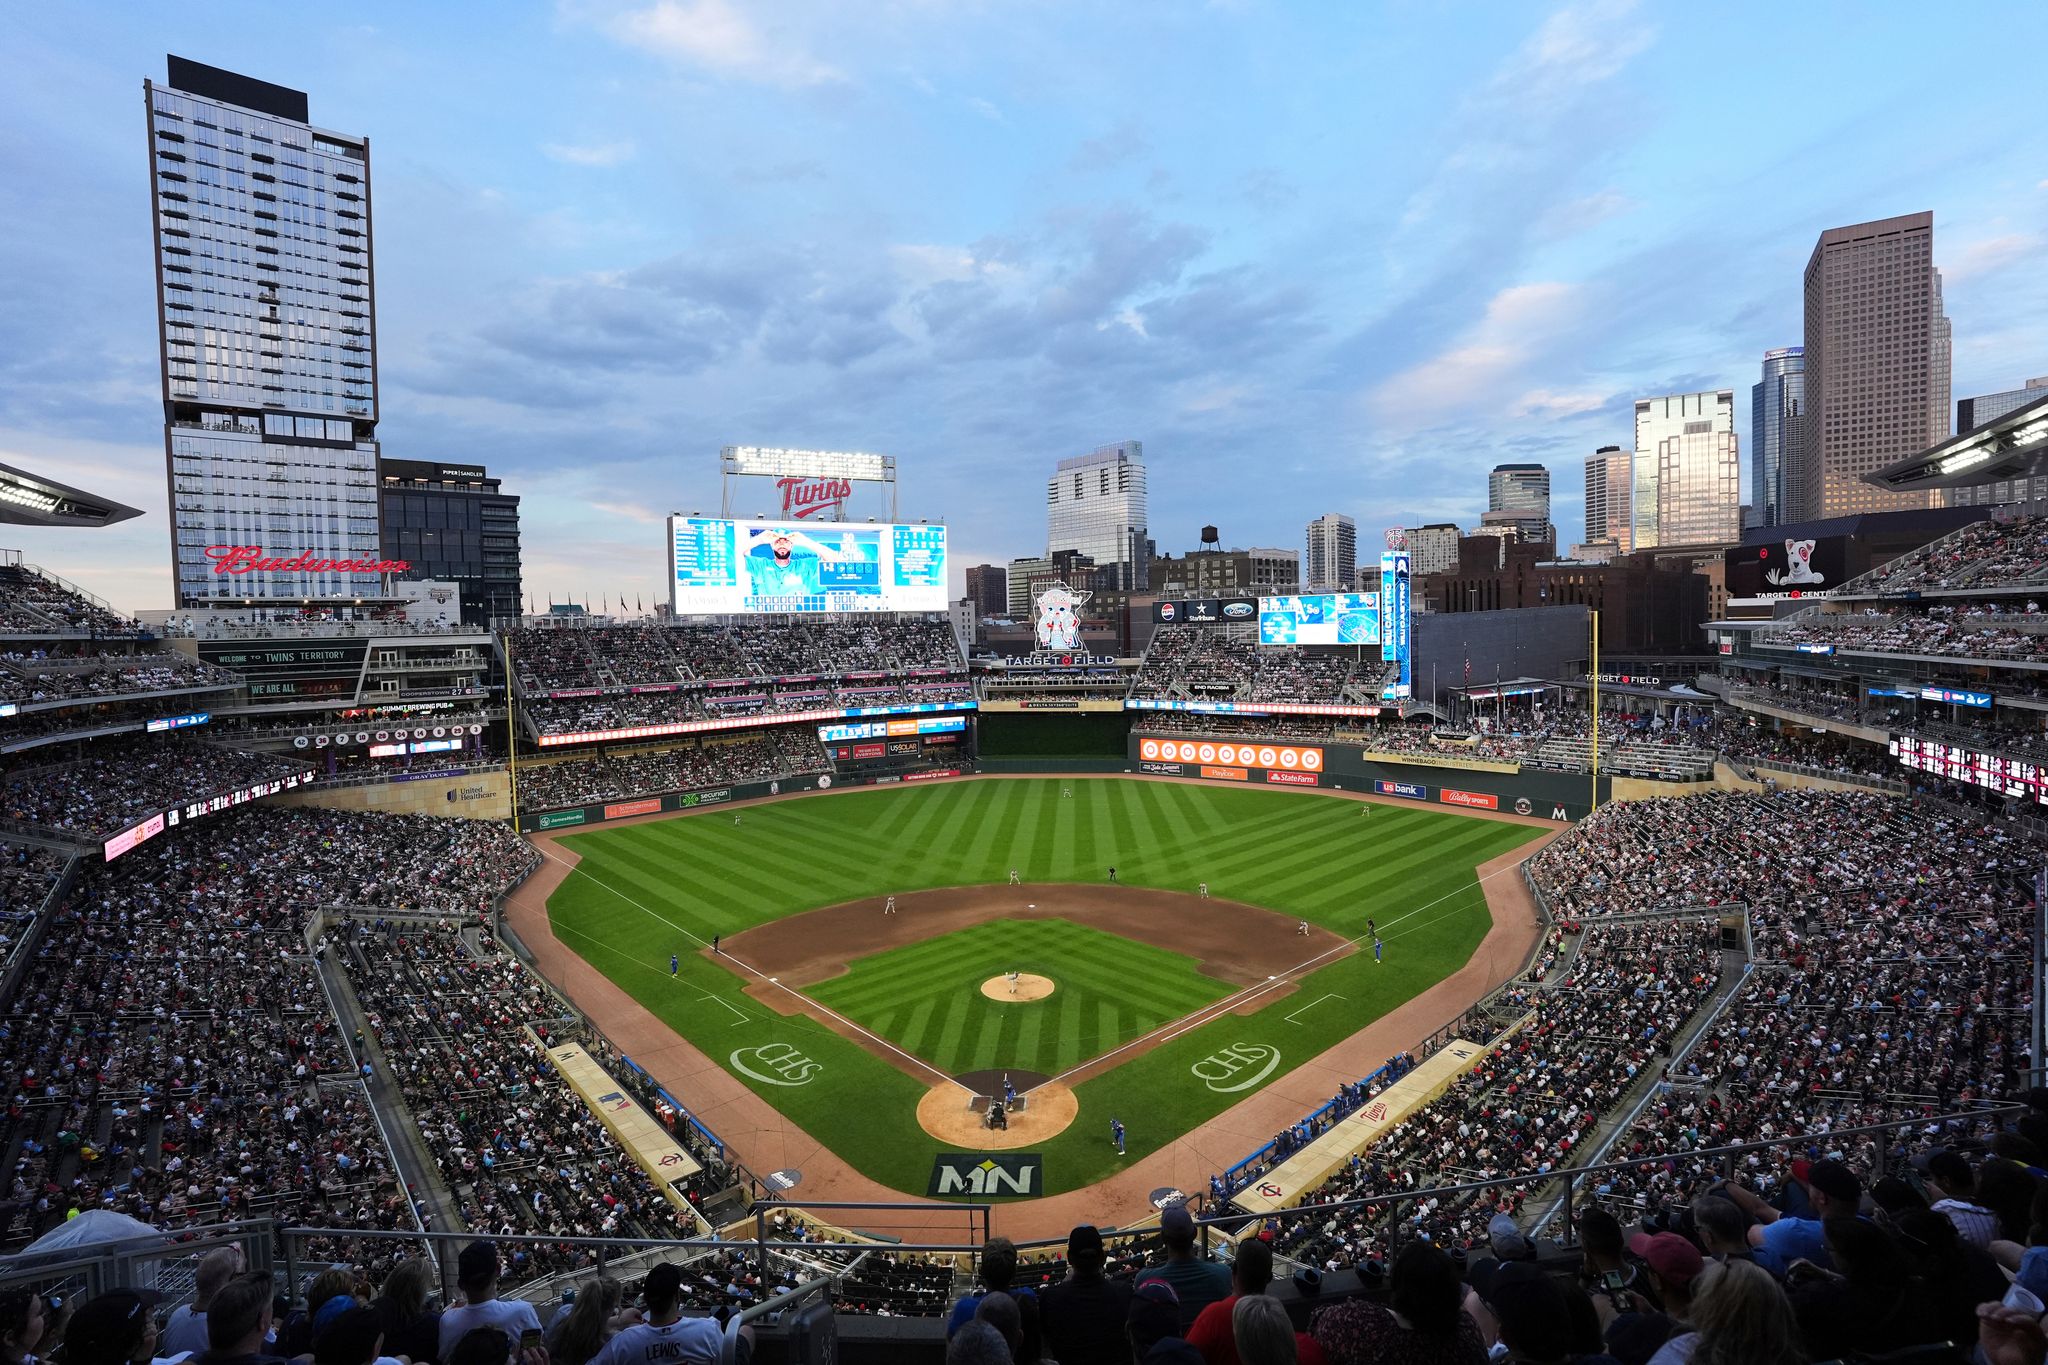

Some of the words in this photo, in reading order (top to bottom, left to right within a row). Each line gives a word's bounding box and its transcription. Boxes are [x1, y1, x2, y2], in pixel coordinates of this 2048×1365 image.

[777, 475, 851, 511] Twins
[204, 546, 414, 575] Budweiser
[1228, 606, 1248, 615] Ford
[219, 655, 247, 663] WELCOME
[265, 653, 295, 662] TWINS
[300, 651, 345, 660] TERRITORY
[1006, 657, 1060, 666] TARGET
[1074, 656, 1115, 665] FIELD
[1585, 674, 1621, 682] TARGET
[1631, 676, 1660, 684] FIELD
[251, 685, 264, 694] WE
[266, 684, 281, 693] ARE
[282, 683, 295, 693] ALL
[451, 688, 462, 696] 27
[408, 703, 435, 711] BREWING
[1401, 757, 1437, 765] WINNEBAGO
[1436, 760, 1473, 769] INDUSTRIES
[1562, 763, 1580, 771] Corona
[1212, 769, 1234, 777] Paycor
[1658, 772, 1679, 780] Corona
[460, 786, 483, 794] United
[1384, 782, 1394, 791] us
[1395, 783, 1416, 795] bank
[460, 792, 497, 801] Healthcare
[700, 790, 728, 799] securian
[1449, 792, 1472, 805] Bally
[1472, 797, 1489, 805] SPORTS
[1552, 808, 1568, 821] M
[756, 1043, 824, 1081] CHS
[1191, 1042, 1268, 1080] CHS
[1360, 1102, 1387, 1123] Twins
[646, 1342, 681, 1361] LEWIS
